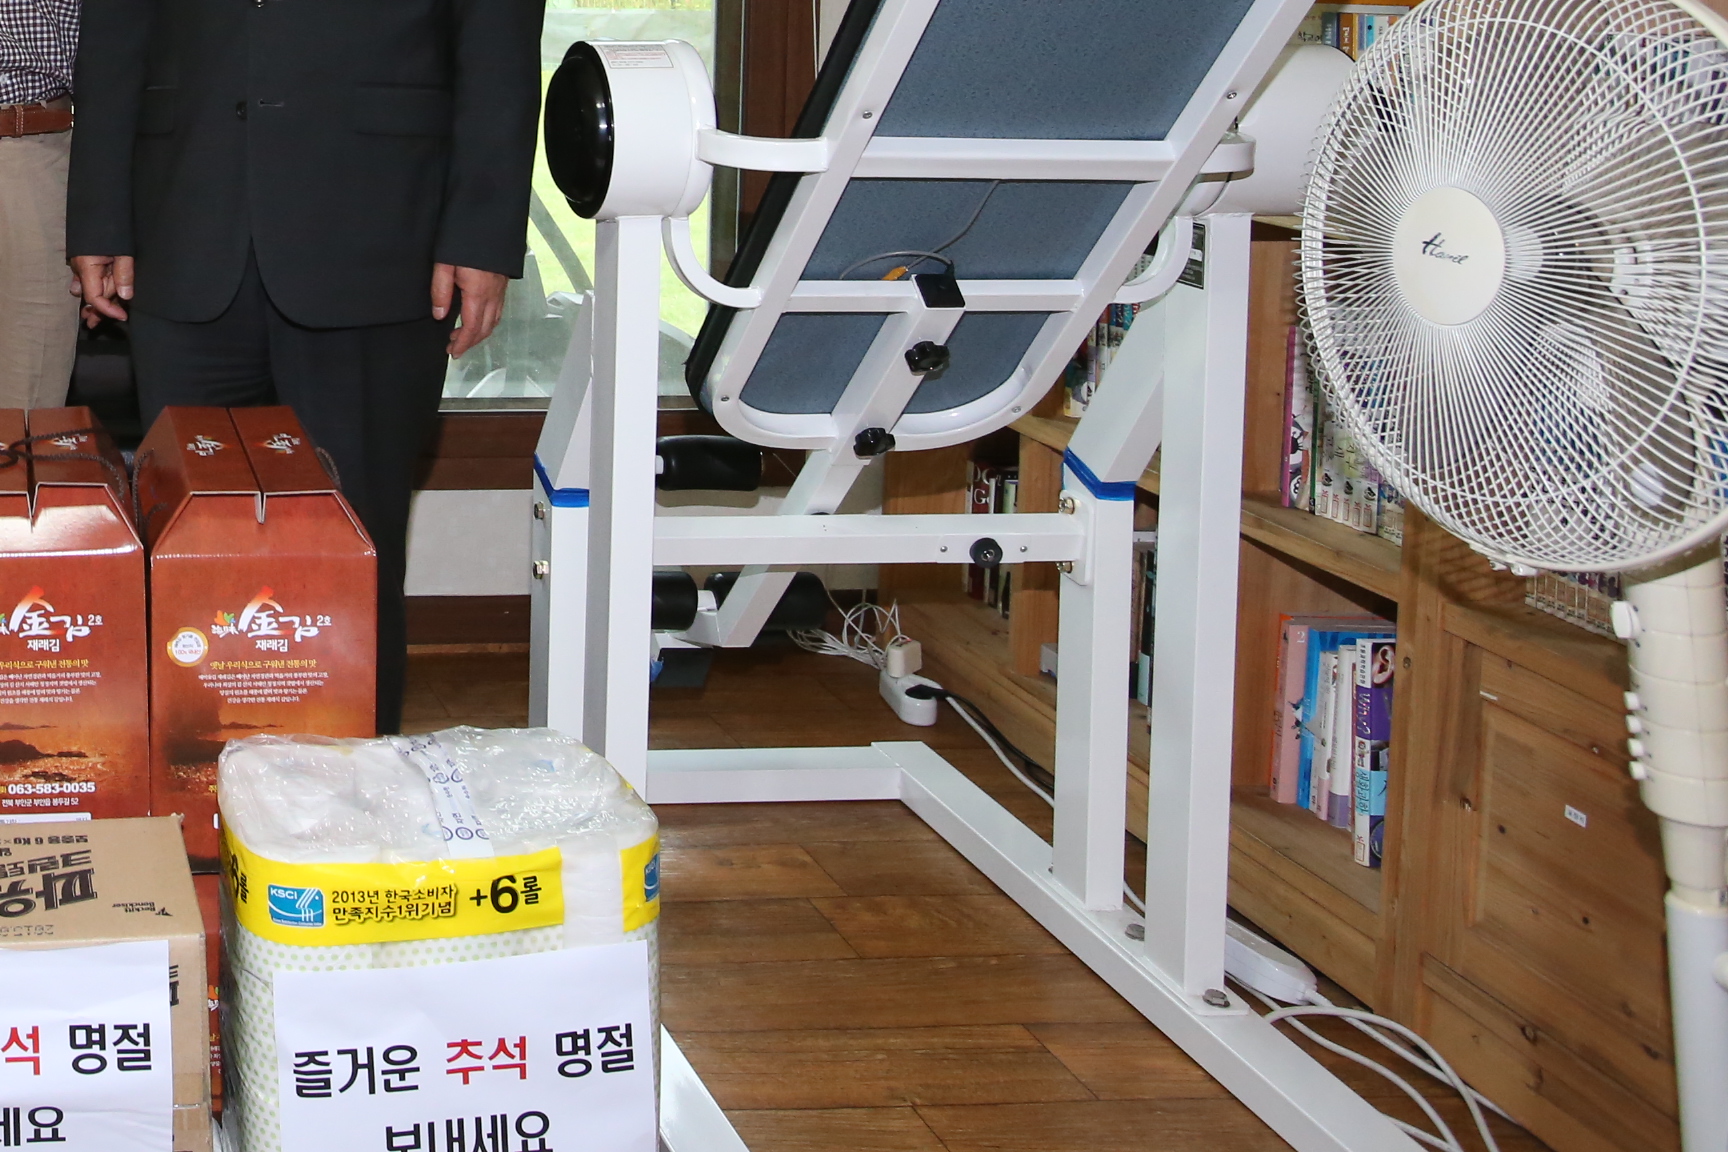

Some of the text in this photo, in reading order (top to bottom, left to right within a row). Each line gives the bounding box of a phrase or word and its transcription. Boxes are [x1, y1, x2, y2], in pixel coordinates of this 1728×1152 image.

[88, 614, 103, 626] 2호
[316, 615, 332, 626] 2호
[27, 639, 60, 653] 재래김
[256, 639, 288, 652] 재래김
[7, 781, 96, 795] 063-583-0035
[71, 798, 79, 806] 52
[35, 836, 44, 845] 6
[270, 886, 298, 900] KSCI
[332, 885, 455, 904] 2013년 한국소비자
[333, 901, 452, 921] 만족지수1위기념
[69, 1022, 153, 1075] 명절
[293, 1023, 635, 1098] 즐거운 추석 명절
[385, 1111, 553, 1152] 보내세요
